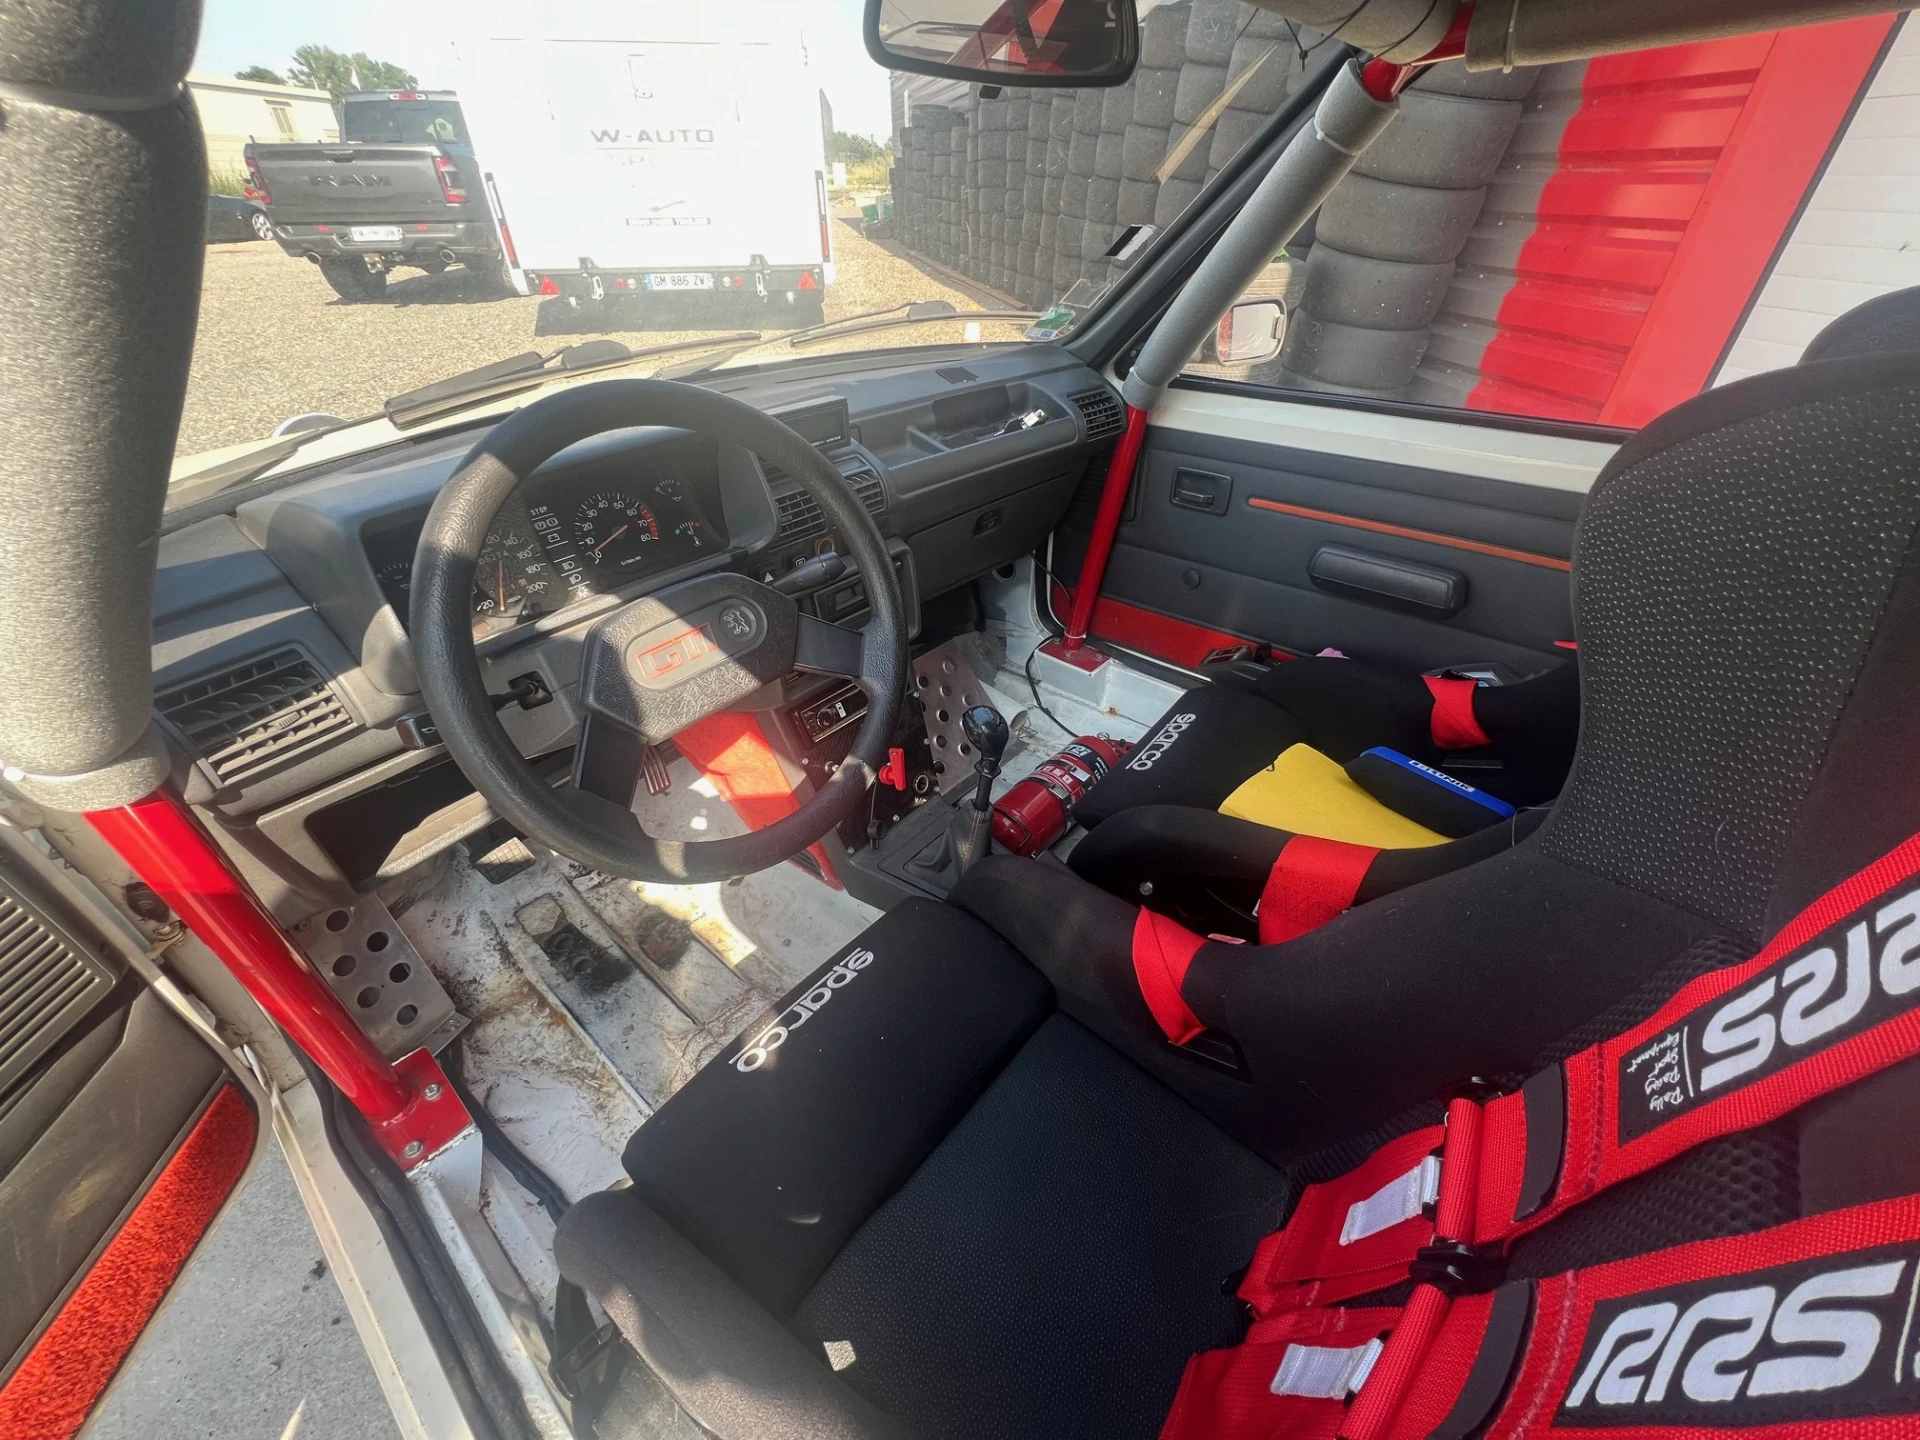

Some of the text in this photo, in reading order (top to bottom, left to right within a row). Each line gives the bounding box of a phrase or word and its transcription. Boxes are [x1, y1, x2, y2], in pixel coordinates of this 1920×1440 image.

[590, 129, 714, 143] W-AUTO
[308, 174, 392, 187] RAM
[654, 275, 667, 286] GM
[670, 274, 689, 286] 886
[598, 500, 608, 508] 40
[613, 501, 624, 510] 50
[530, 506, 548, 516] STOP
[586, 509, 598, 518] 30
[626, 508, 638, 517] 60
[582, 522, 593, 531] 20
[637, 519, 648, 528] 70
[503, 536, 519, 547] 140
[585, 537, 595, 546] 10
[640, 533, 652, 542] 80
[517, 550, 532, 560] 160
[595, 551, 602, 559] 0
[525, 564, 541, 574] 180
[526, 582, 543, 593] 200
[480, 599, 494, 610] 20
[636, 622, 719, 679] GTI
[1127, 712, 1197, 772] sparco
[733, 948, 875, 1073] sparco
[1564, 1259, 1907, 1408] RRS
